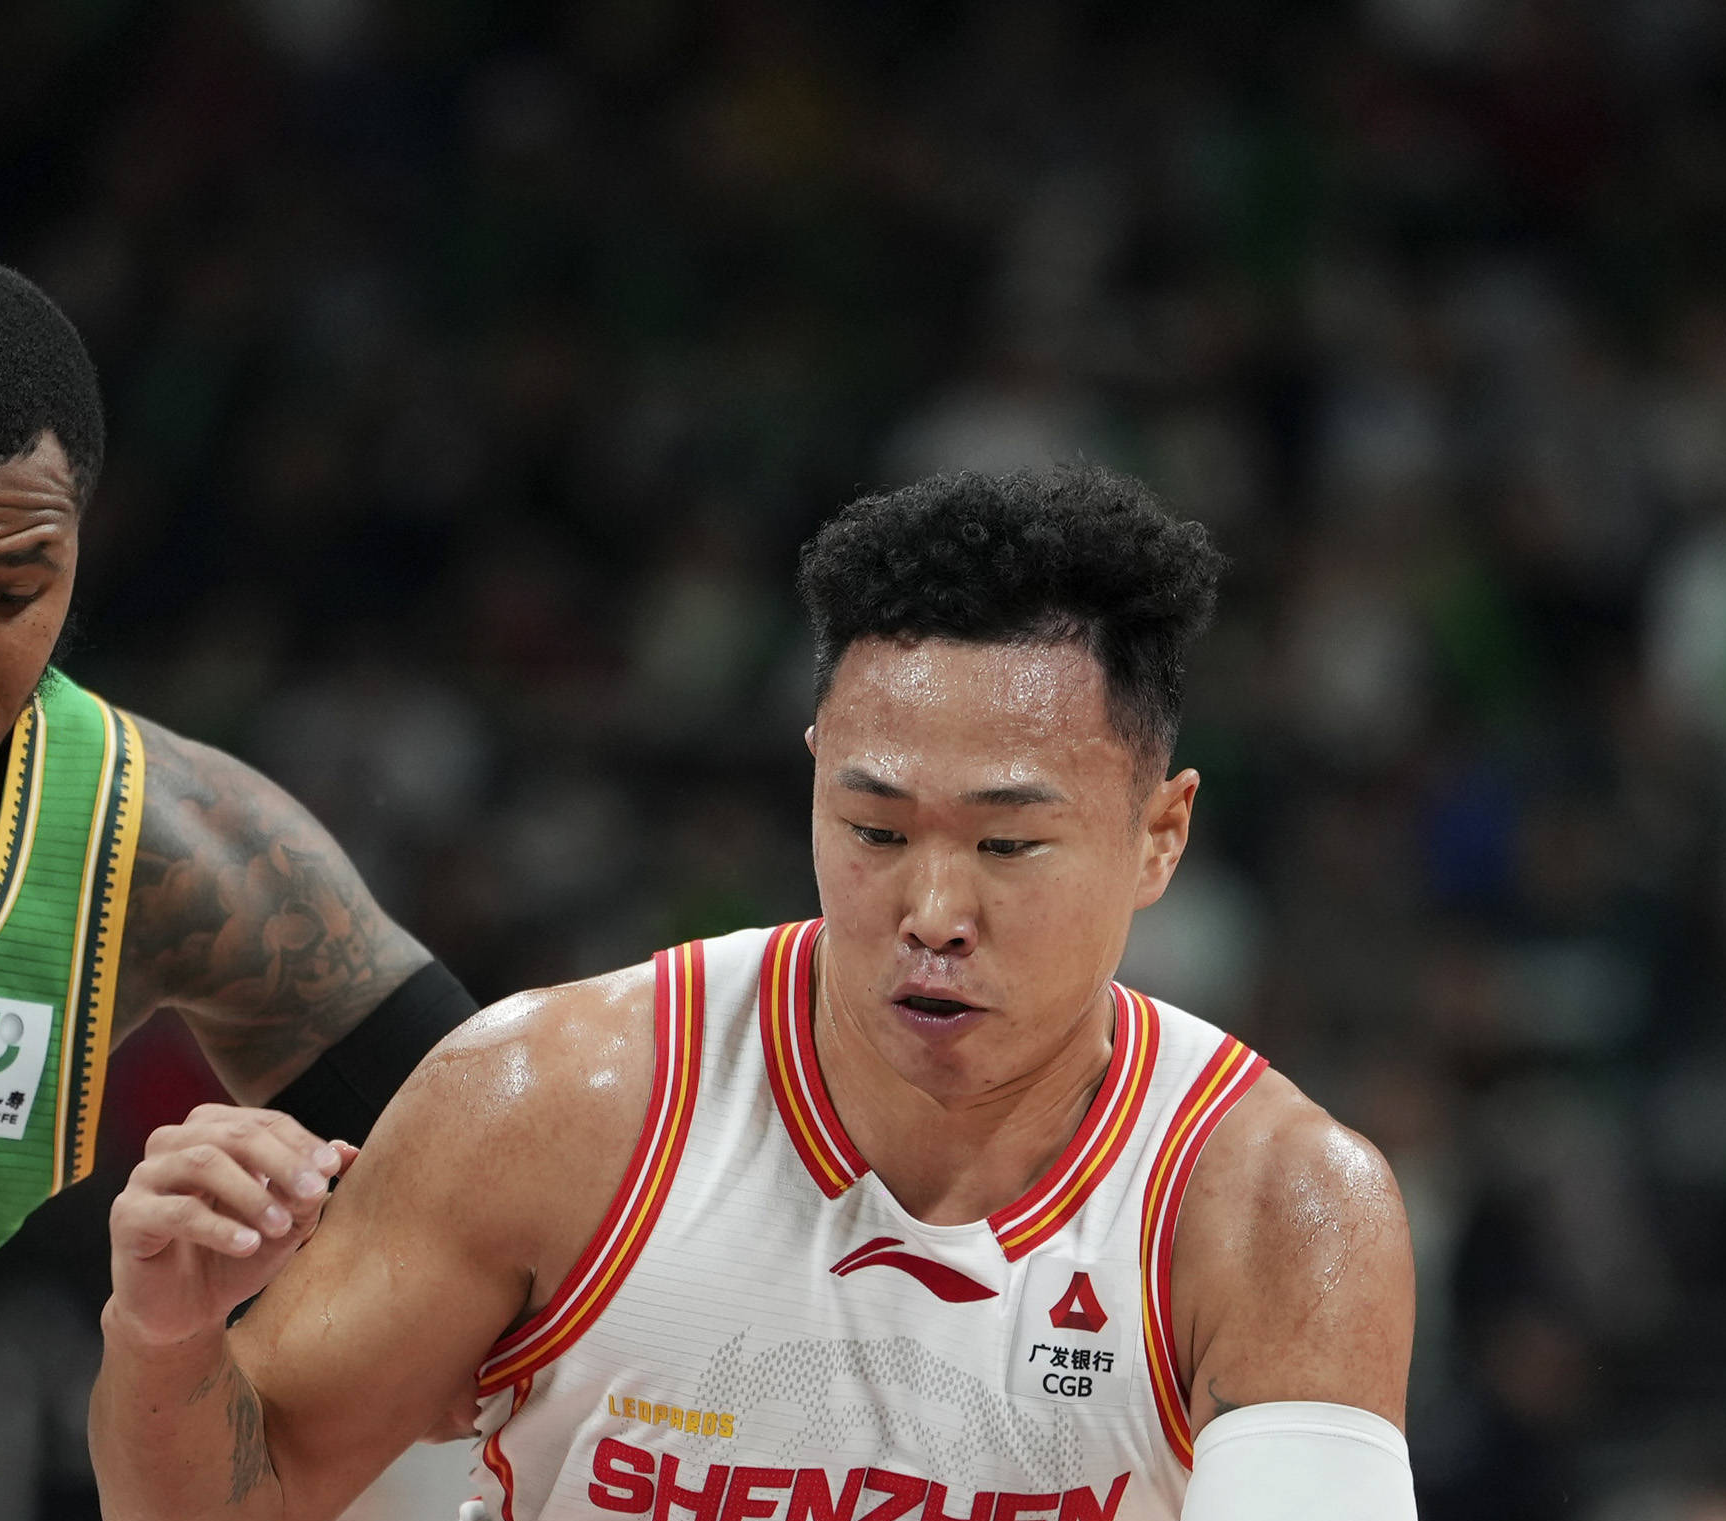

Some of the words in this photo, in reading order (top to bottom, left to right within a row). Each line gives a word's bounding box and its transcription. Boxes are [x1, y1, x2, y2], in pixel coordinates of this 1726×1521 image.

[1028, 1343, 1115, 1374] 广发银行
[1042, 1373, 1093, 1398] CGB
[608, 1394, 735, 1439] LEOPARDS
